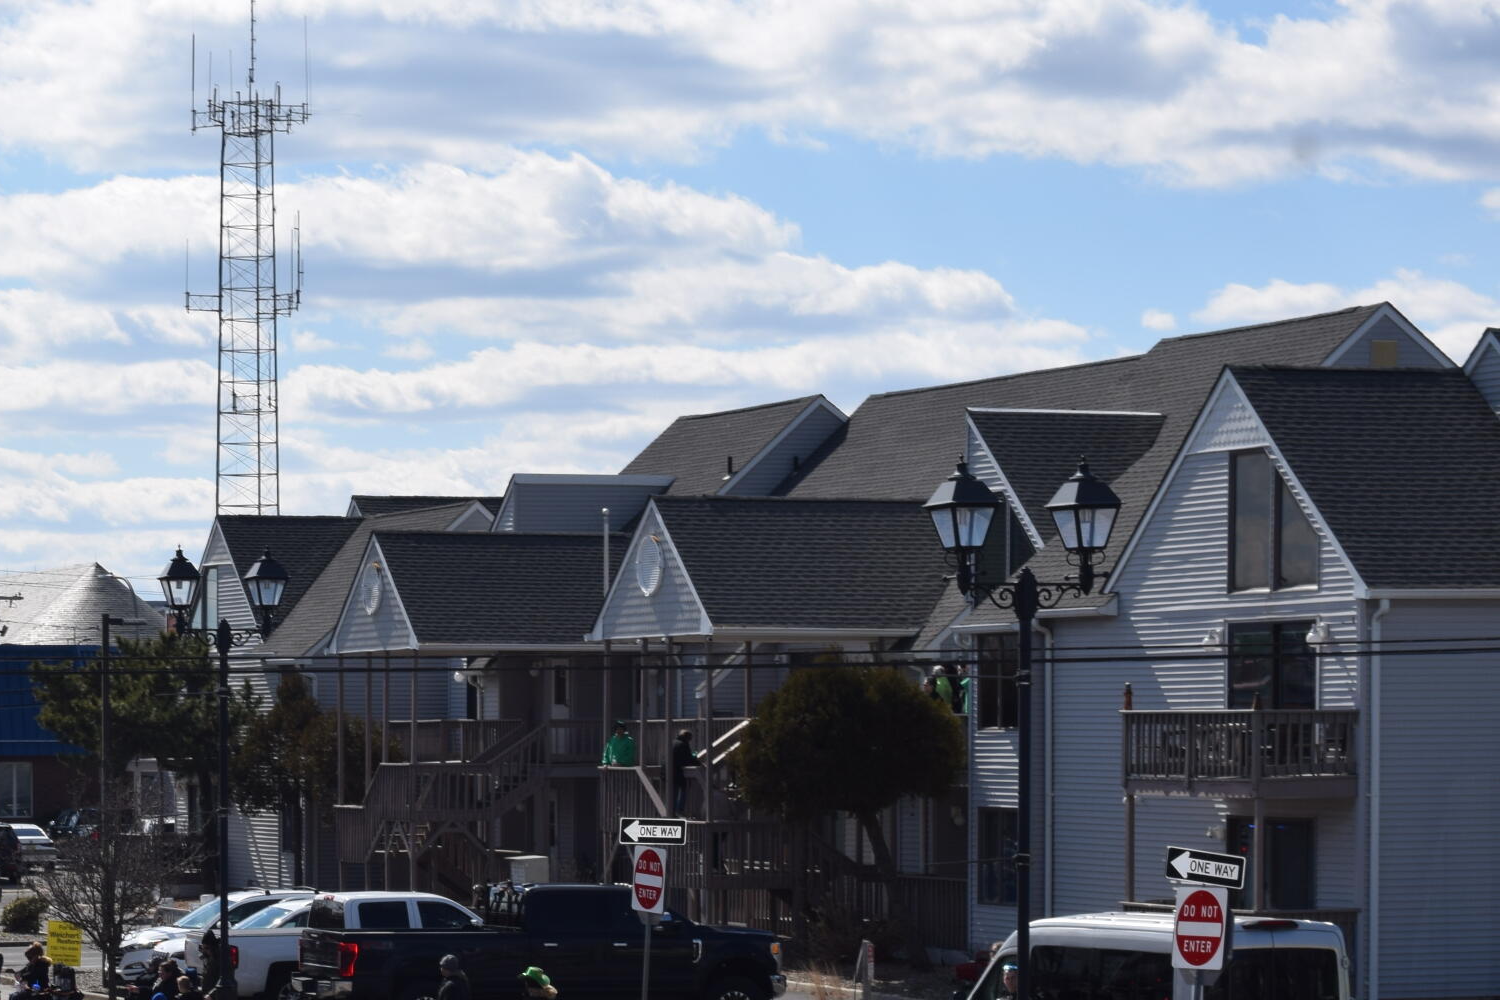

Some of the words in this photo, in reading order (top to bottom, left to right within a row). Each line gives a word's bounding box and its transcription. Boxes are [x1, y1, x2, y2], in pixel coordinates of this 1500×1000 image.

[639, 826, 657, 836] ONE
[660, 827, 679, 837] WAY
[638, 859, 647, 870] DO
[649, 861, 661, 872] NOT
[1190, 860, 1210, 874] ONE
[1214, 863, 1236, 878] WAY
[638, 888, 657, 900] ENTER
[1183, 904, 1195, 917] DO
[1201, 905, 1218, 918] NOT
[1183, 939, 1212, 953] ENTER
